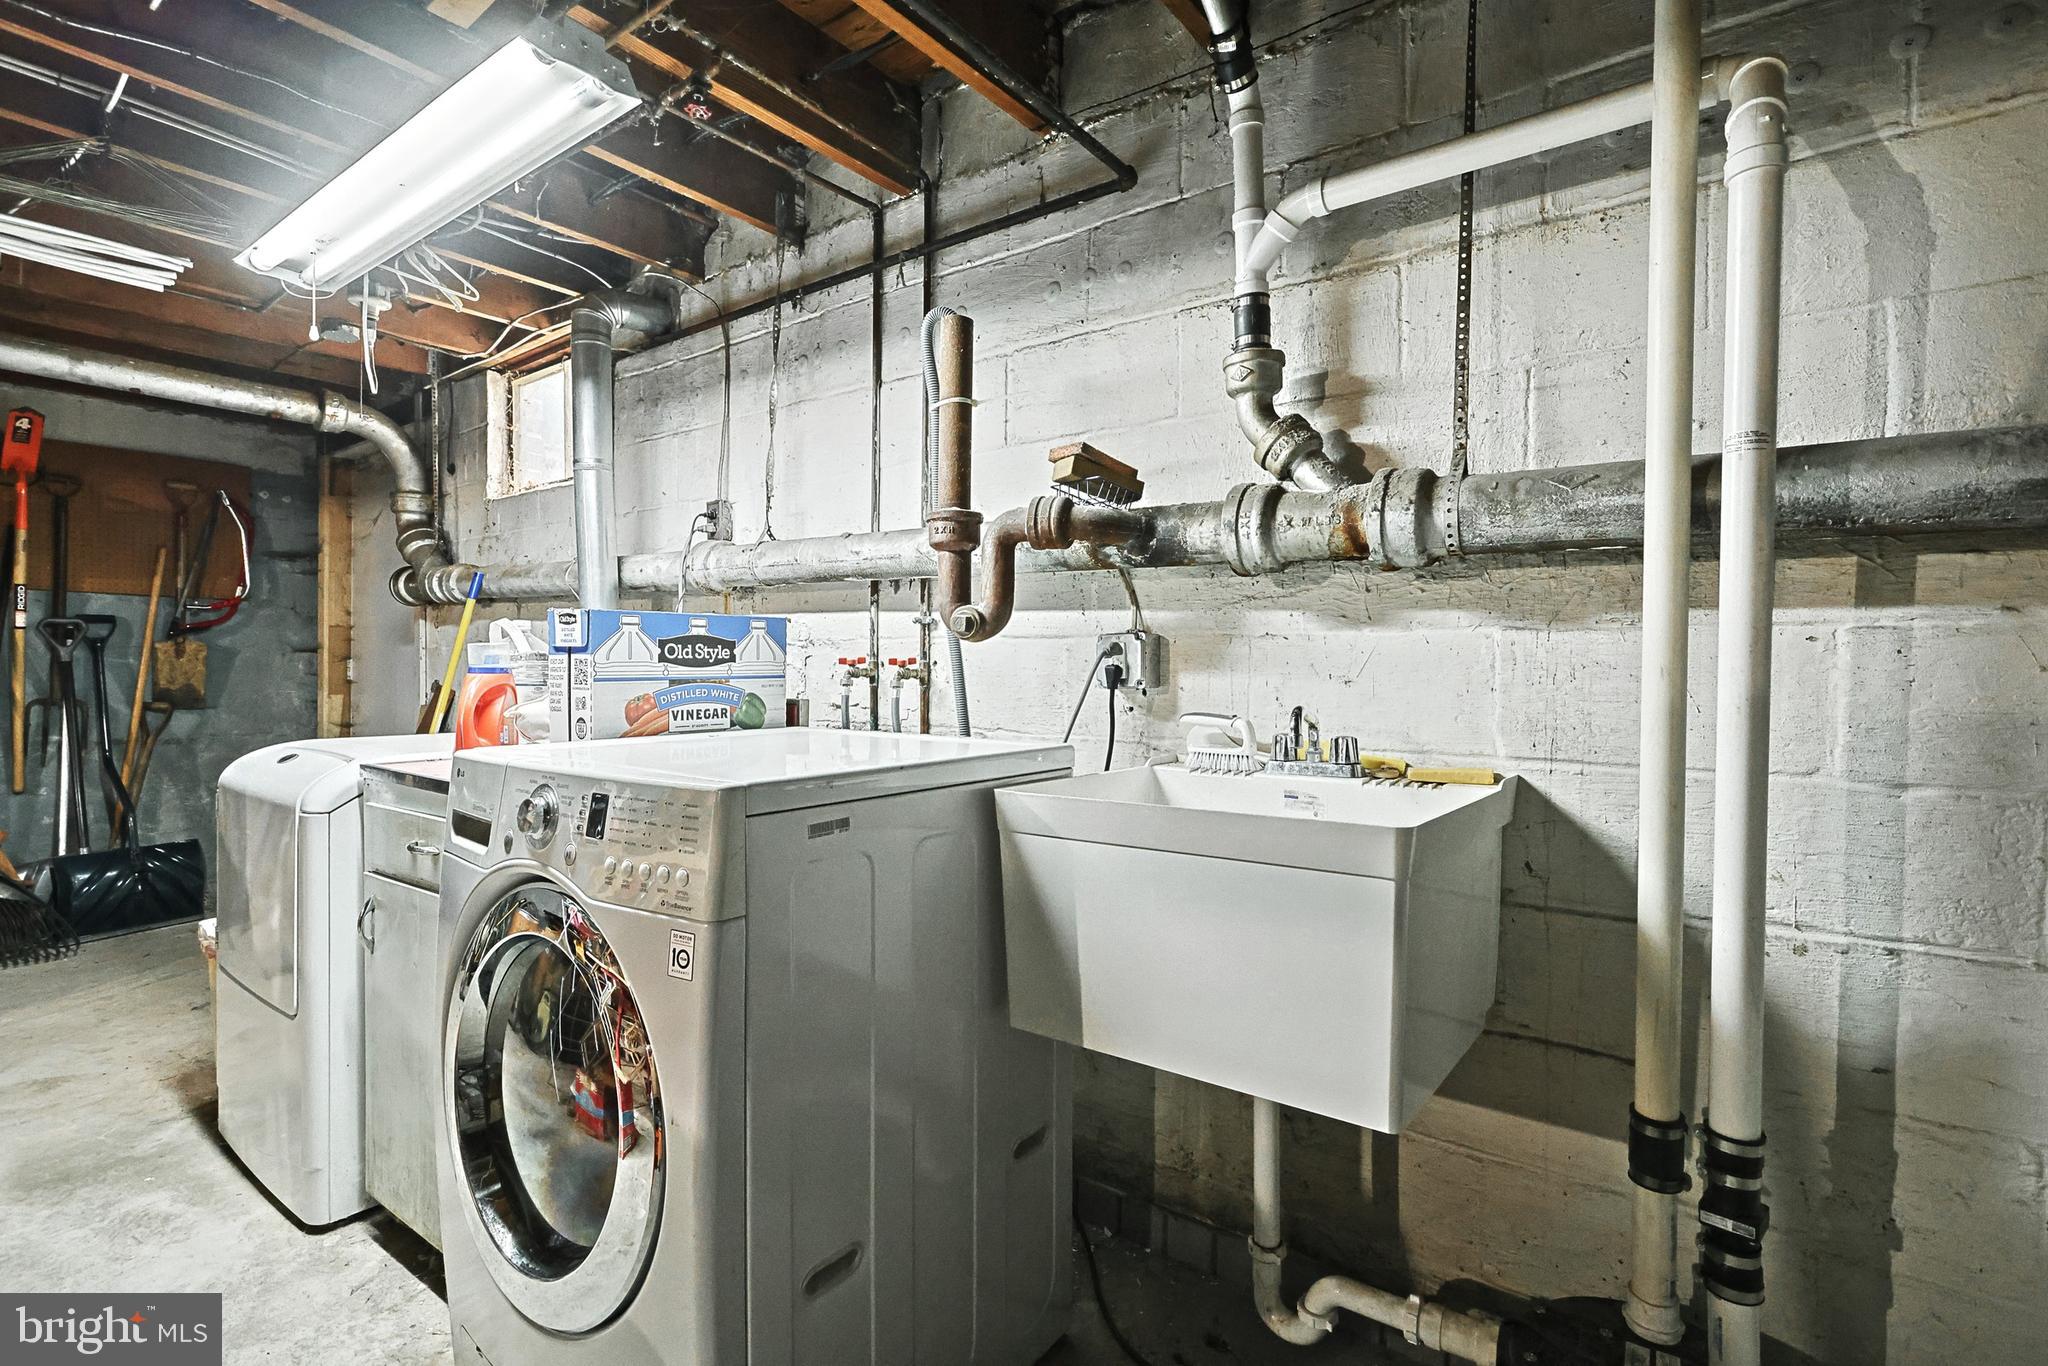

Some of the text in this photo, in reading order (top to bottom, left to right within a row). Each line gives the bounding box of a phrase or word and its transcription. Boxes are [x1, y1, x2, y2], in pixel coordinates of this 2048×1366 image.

[15, 418, 32, 430] 4
[17, 585, 26, 610] RIDGID
[664, 643, 731, 663] Old Style
[660, 688, 740, 705] DISTILLED WHITE
[671, 707, 729, 721] VINEGAR
[672, 947, 690, 969] 10
